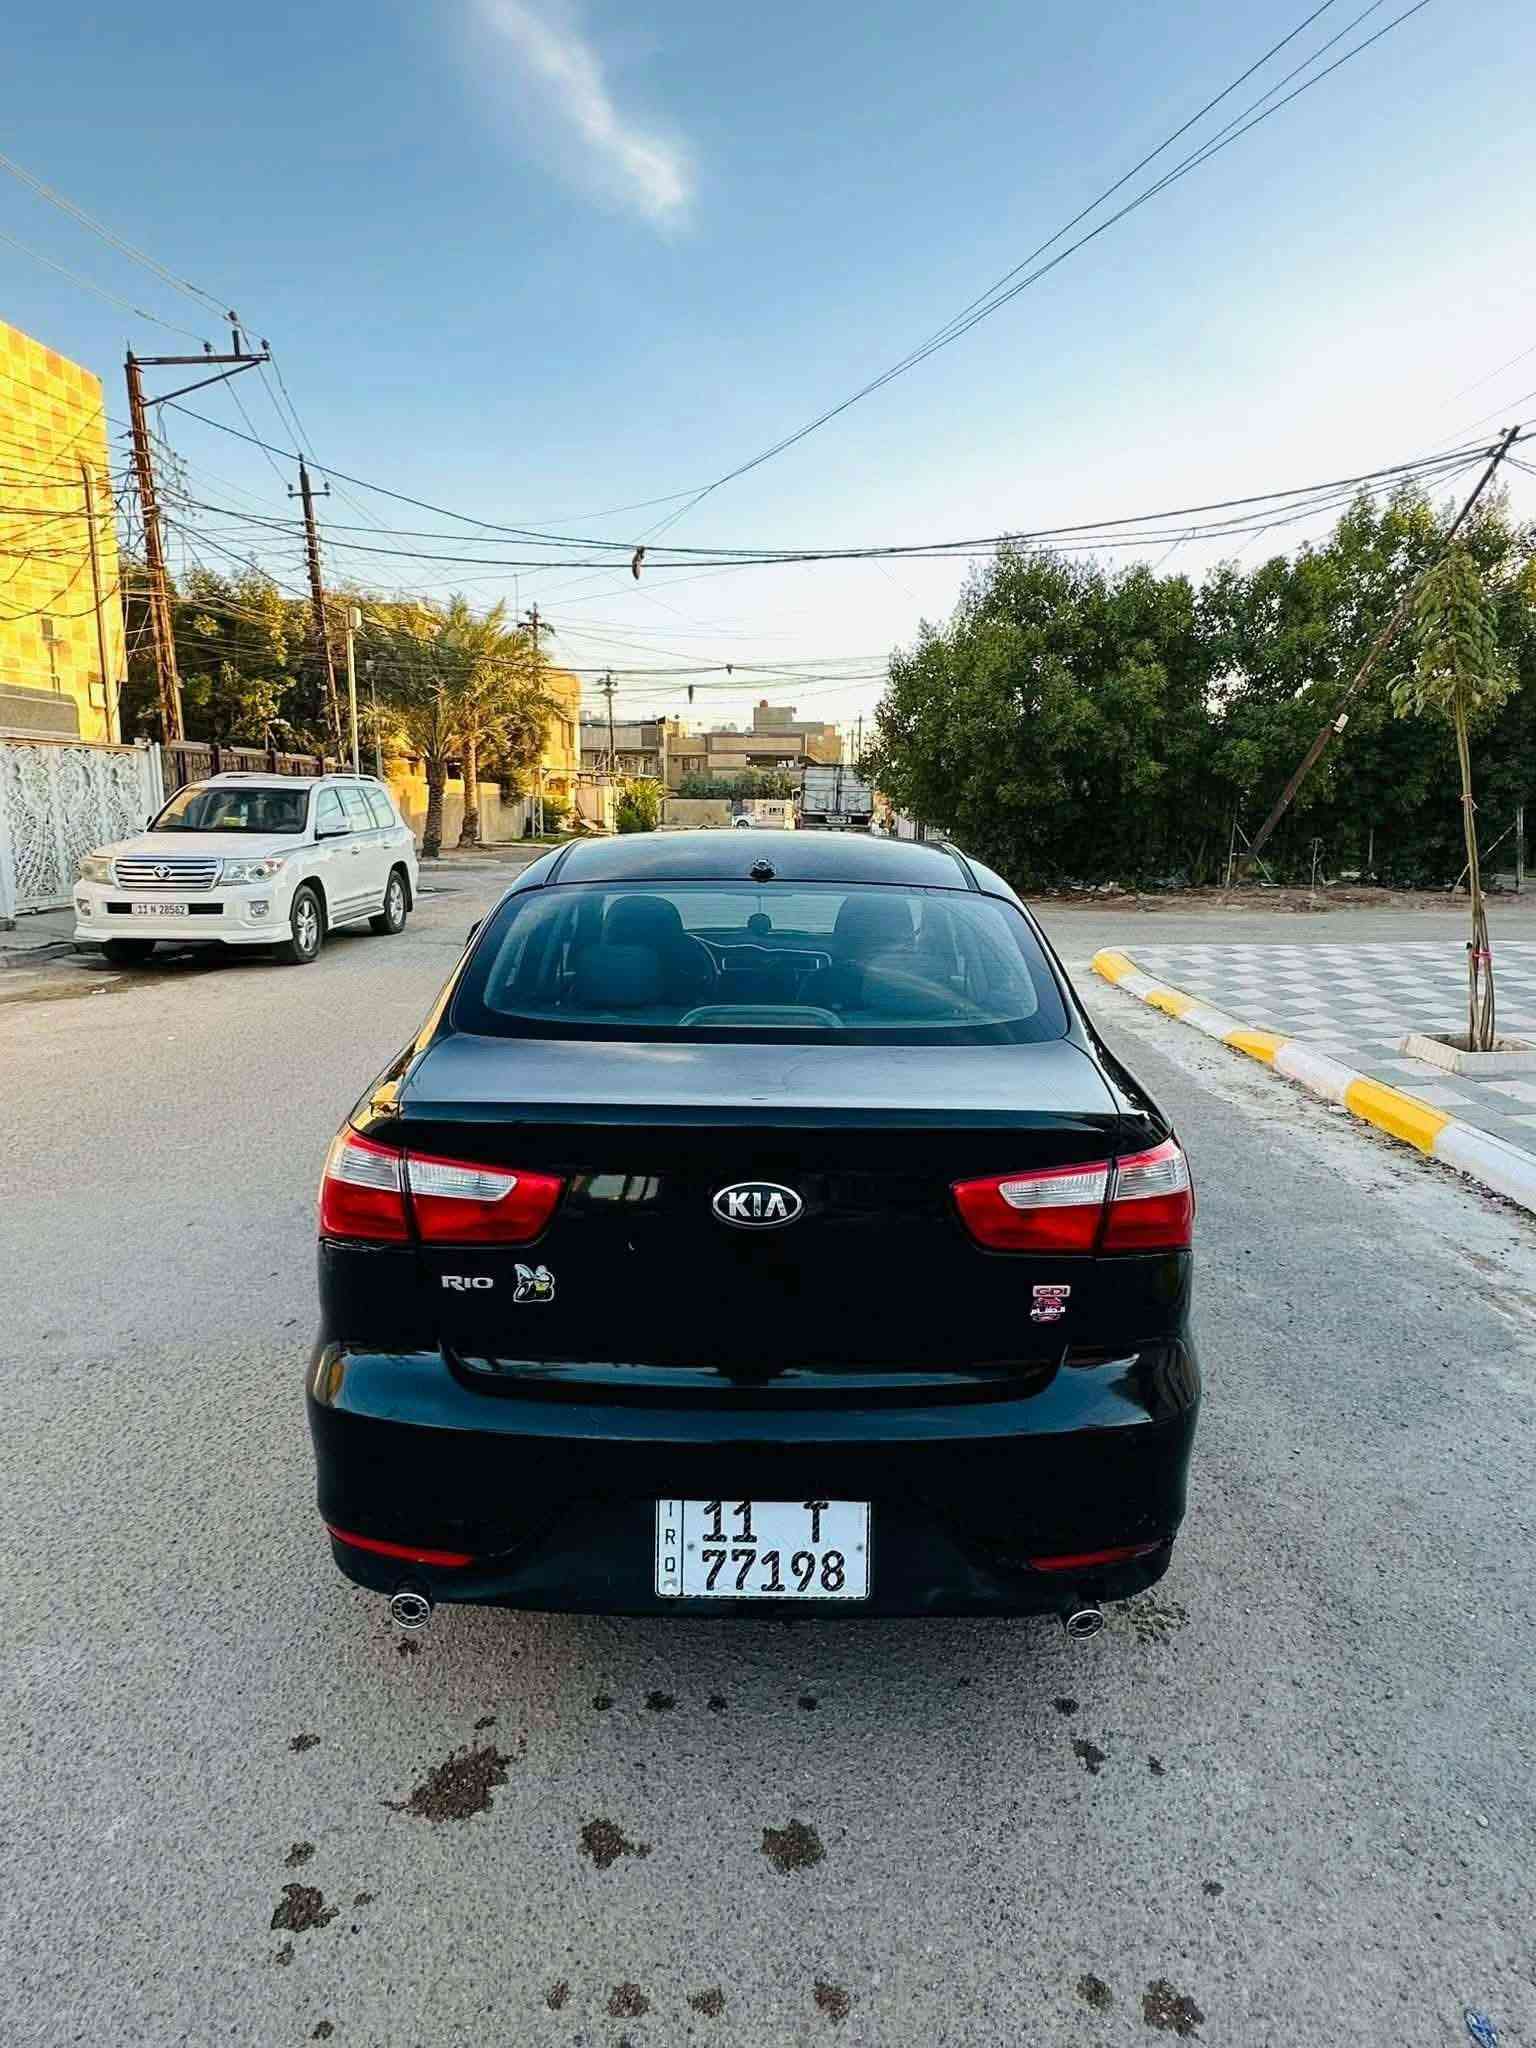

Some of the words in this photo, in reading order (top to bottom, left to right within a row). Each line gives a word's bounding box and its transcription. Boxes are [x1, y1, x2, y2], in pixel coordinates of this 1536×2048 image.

[728, 1192, 788, 1217] KIA
[441, 1275, 494, 1291] RIO
[702, 1500, 757, 1543] 11
[803, 1500, 829, 1543] T
[702, 1550, 845, 1592] 77198
